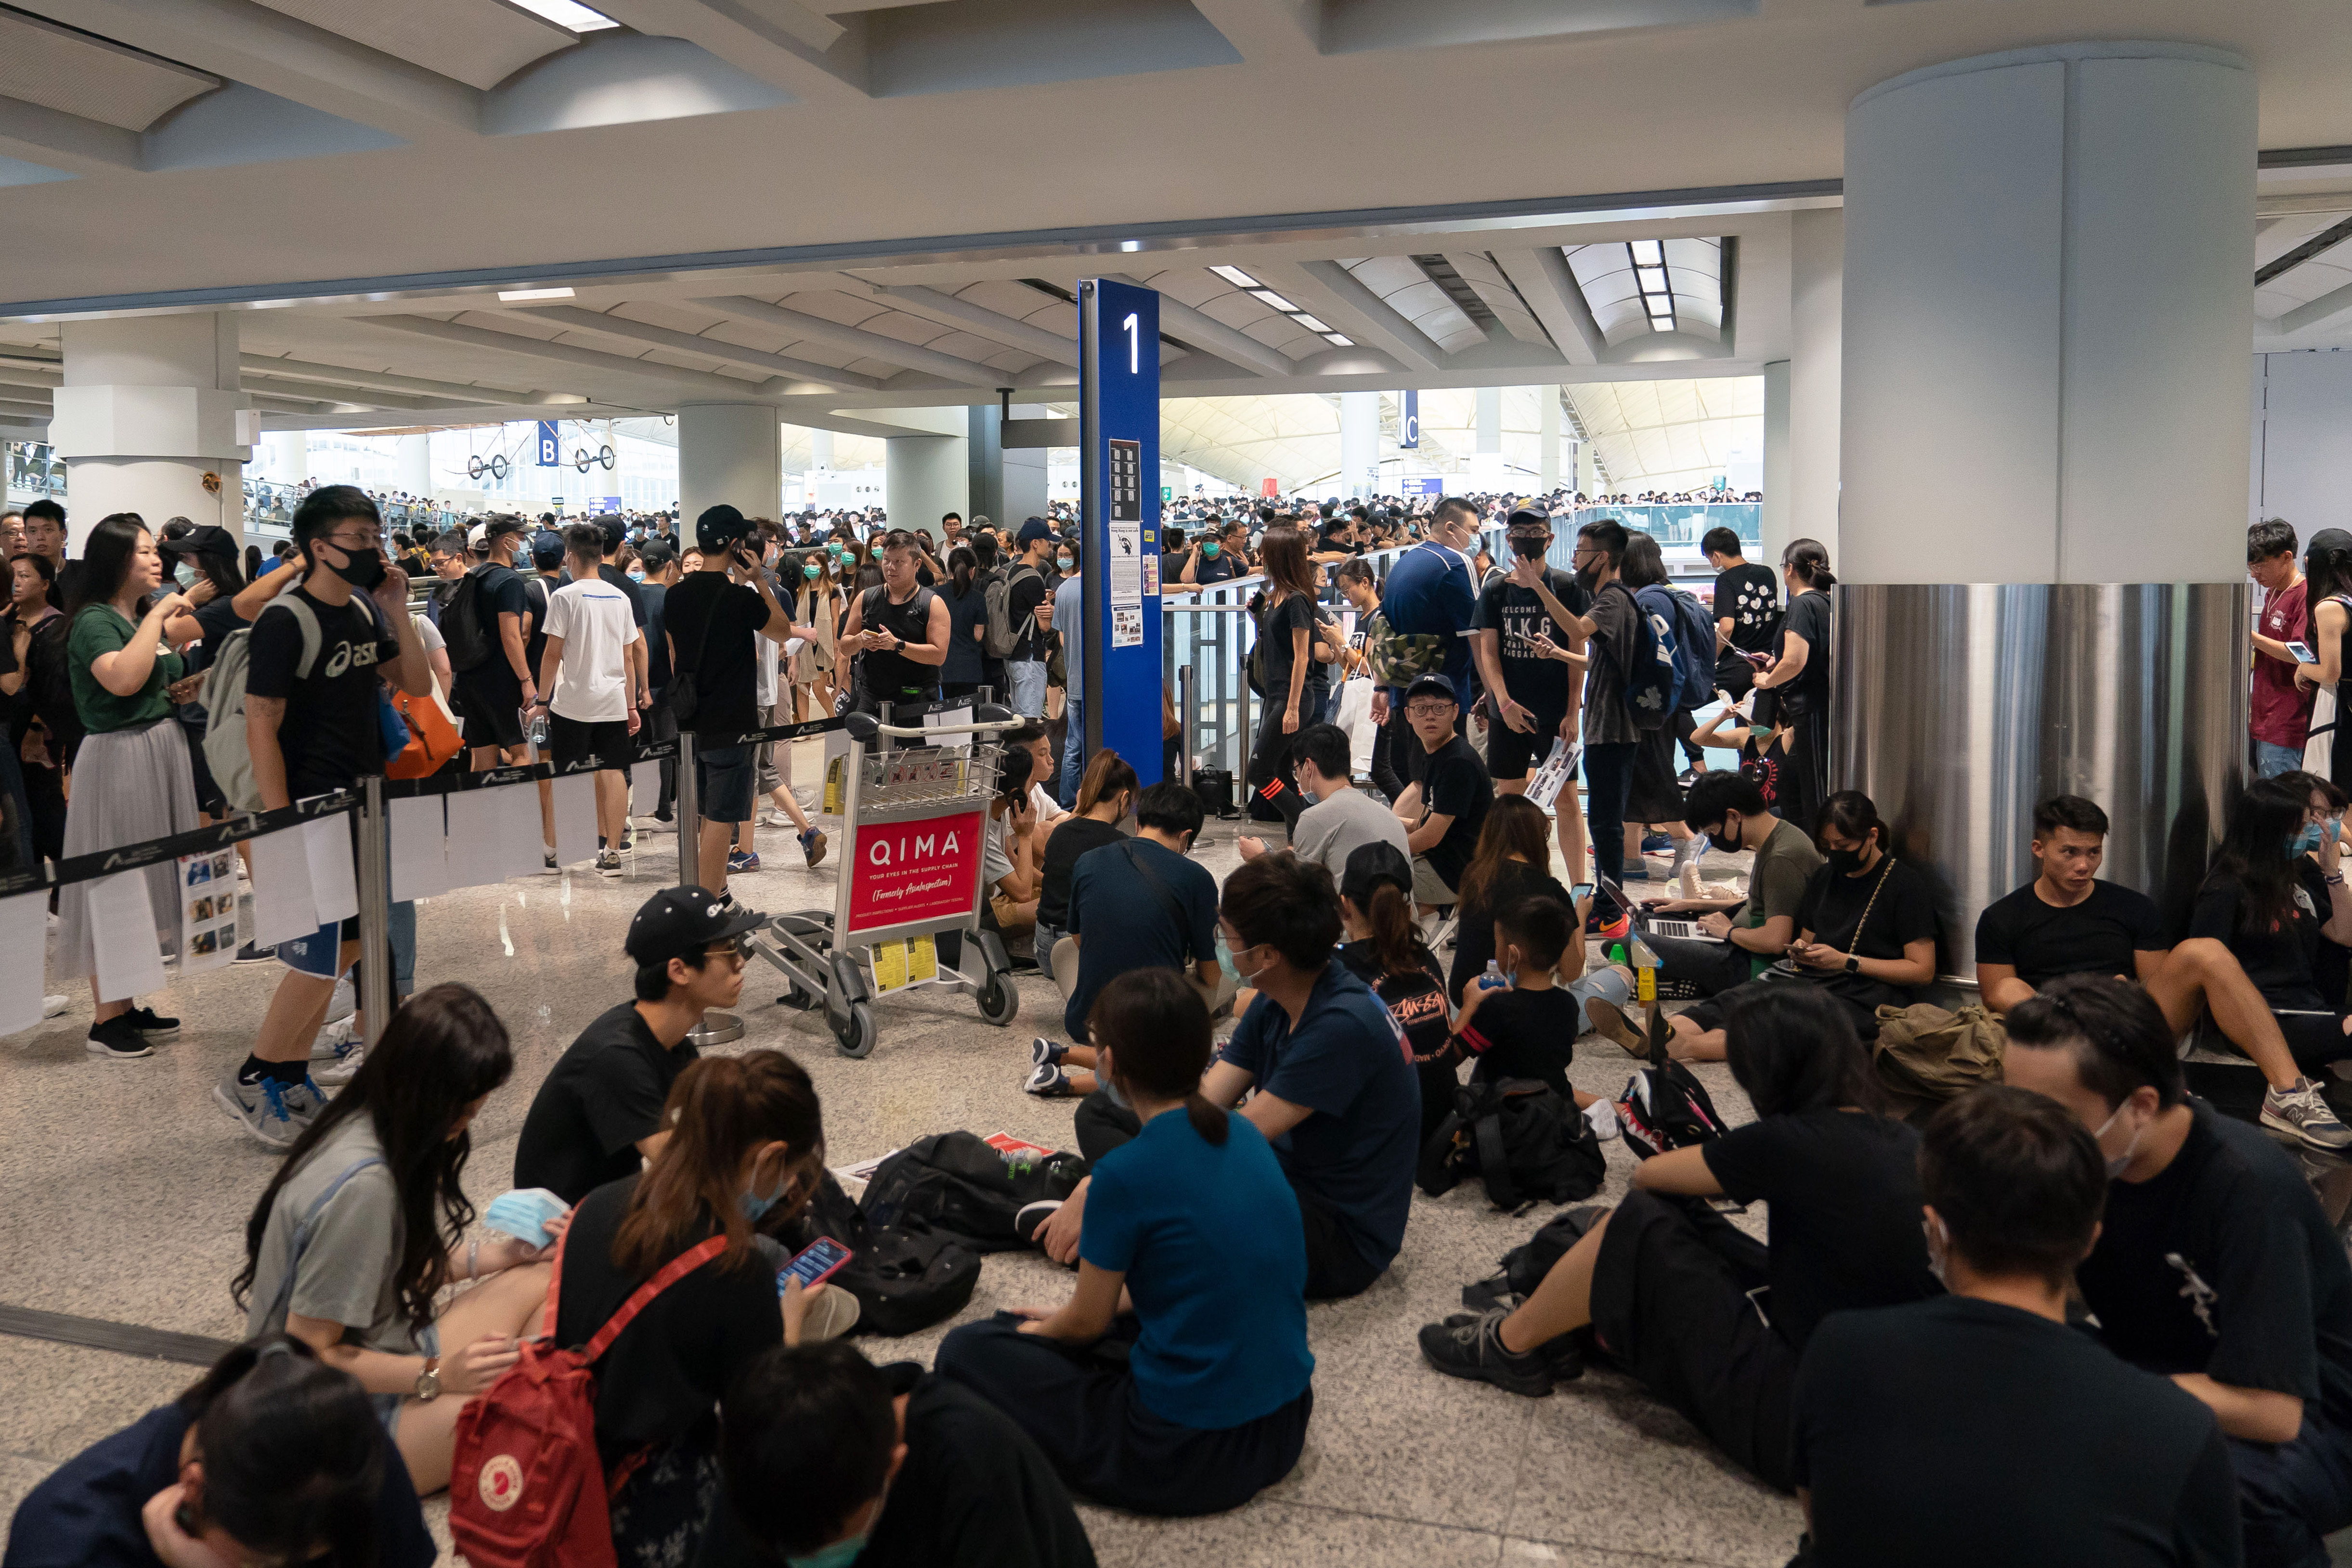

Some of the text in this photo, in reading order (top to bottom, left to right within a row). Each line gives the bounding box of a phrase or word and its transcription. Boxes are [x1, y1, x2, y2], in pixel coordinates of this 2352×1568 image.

[1124, 313, 1138, 374] 1
[1407, 416, 1417, 442] C
[543, 440, 554, 462] B
[1504, 617, 1550, 637] HKG
[870, 831, 959, 865] QIMA
[872, 875, 952, 902] (Formerly AsiaInspection)
